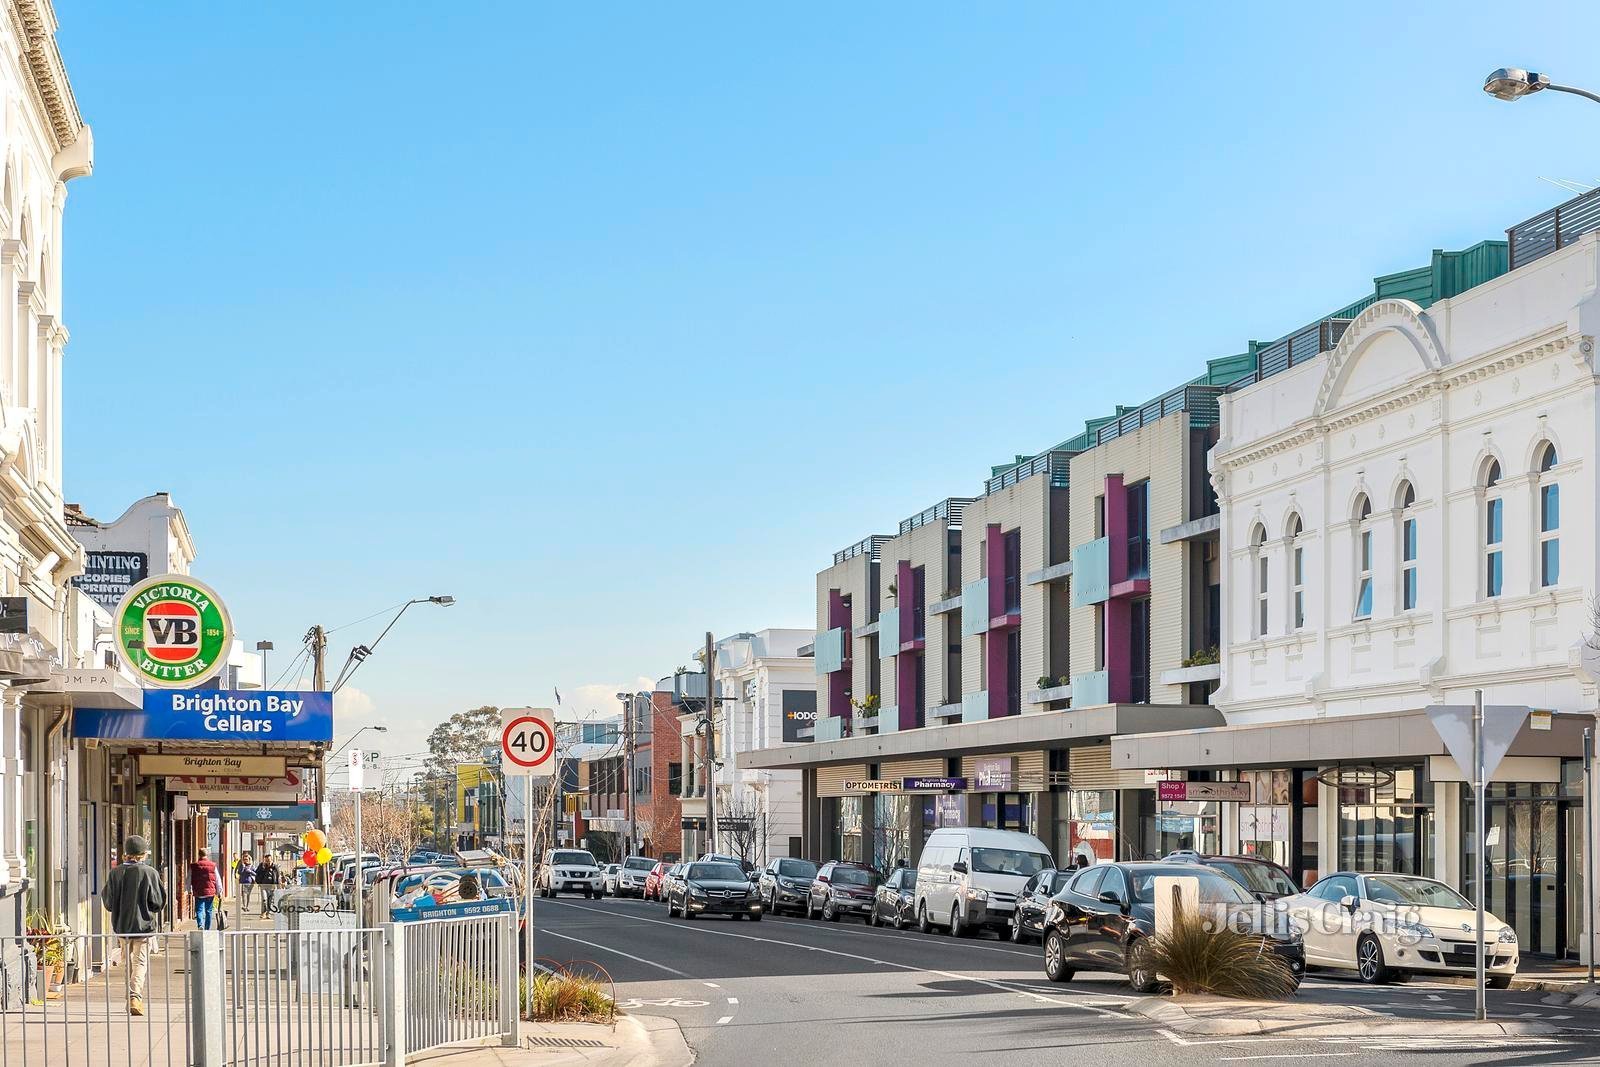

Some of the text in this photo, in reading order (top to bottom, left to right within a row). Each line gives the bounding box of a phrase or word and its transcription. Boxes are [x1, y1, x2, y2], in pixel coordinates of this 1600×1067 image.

[133, 586, 210, 612] VICTORIA
[124, 627, 140, 635] SINCE
[147, 618, 198, 645] VB
[206, 628, 220, 637] 1854
[140, 658, 208, 678] BITTER
[172, 693, 304, 717] Brighton Bay
[203, 714, 273, 732] Cellars
[511, 730, 545, 753] 40
[183, 757, 242, 768] Brighton Bay
[914, 781, 956, 790] Pharmacy
[1161, 782, 1180, 791] Shop
[422, 908, 457, 919] BRIGHTON
